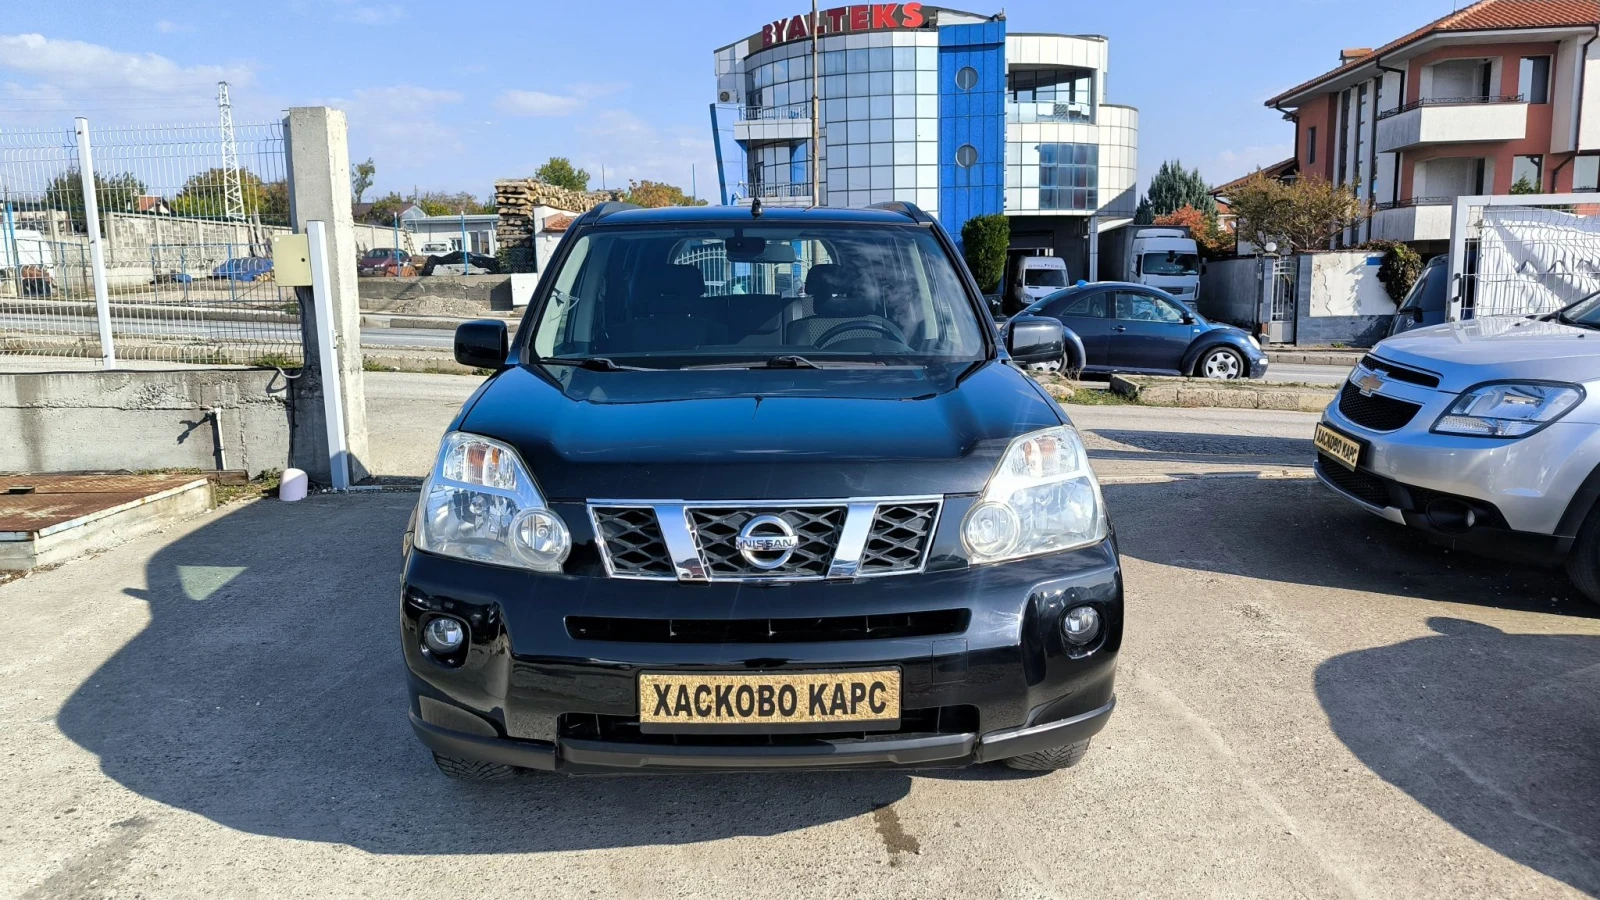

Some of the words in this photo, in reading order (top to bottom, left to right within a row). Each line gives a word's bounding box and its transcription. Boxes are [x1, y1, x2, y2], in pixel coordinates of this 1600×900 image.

[762, 1, 924, 48] BYALTEKS
[1317, 428, 1342, 454] ХАСКОВО
[1342, 442, 1357, 463] КАРС
[742, 539, 792, 548] NISSAN
[653, 683, 797, 717] ХАСКОВО
[809, 681, 887, 716] КАРС
